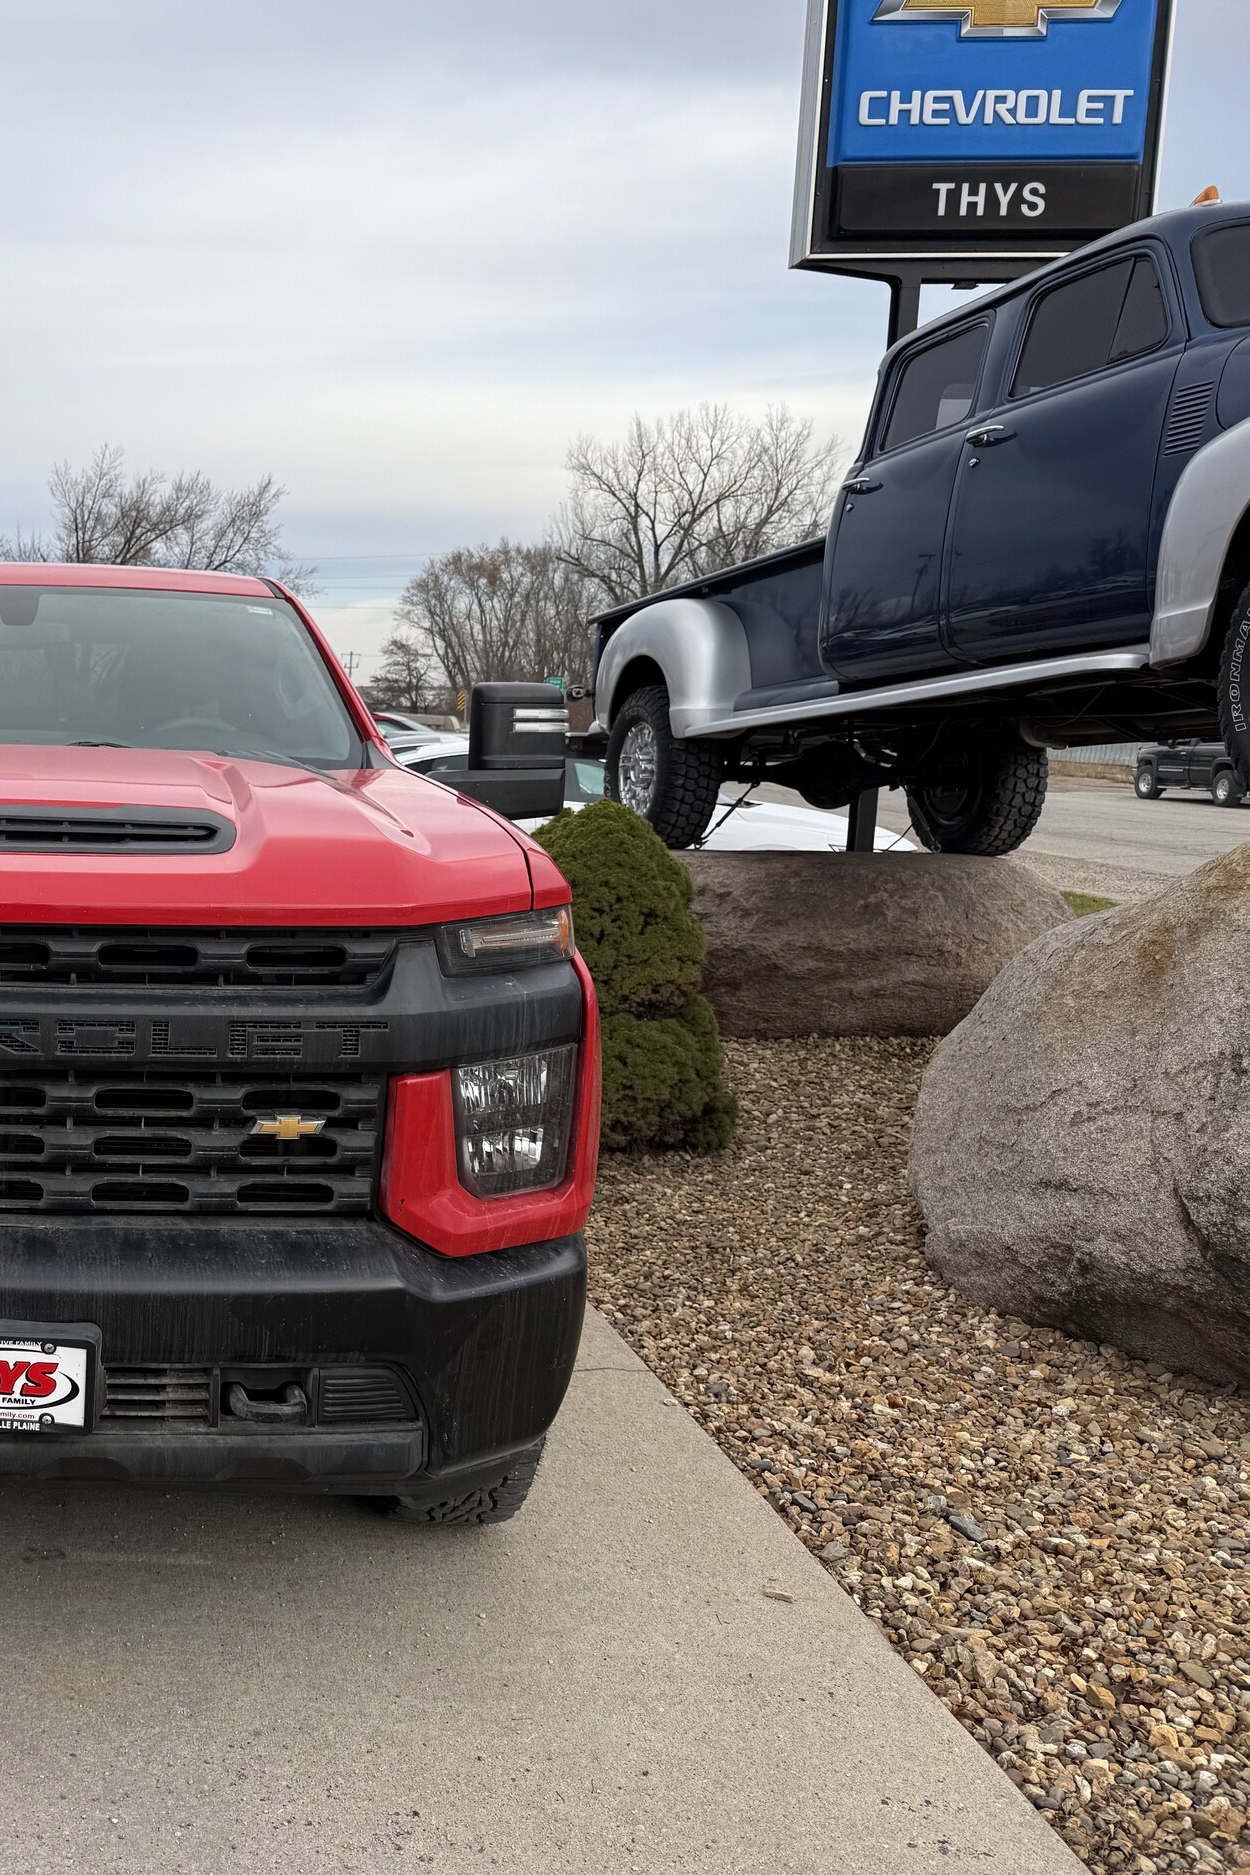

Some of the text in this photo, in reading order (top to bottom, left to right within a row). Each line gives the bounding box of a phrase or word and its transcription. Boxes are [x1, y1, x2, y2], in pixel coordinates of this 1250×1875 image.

[858, 89, 1135, 126] CHEVROLET
[932, 181, 1047, 218] THYS
[1229, 606, 1250, 732] IRONMA
[1, 1396, 37, 1406] FAMILY
[12, 1421, 41, 1431] PLAINE
